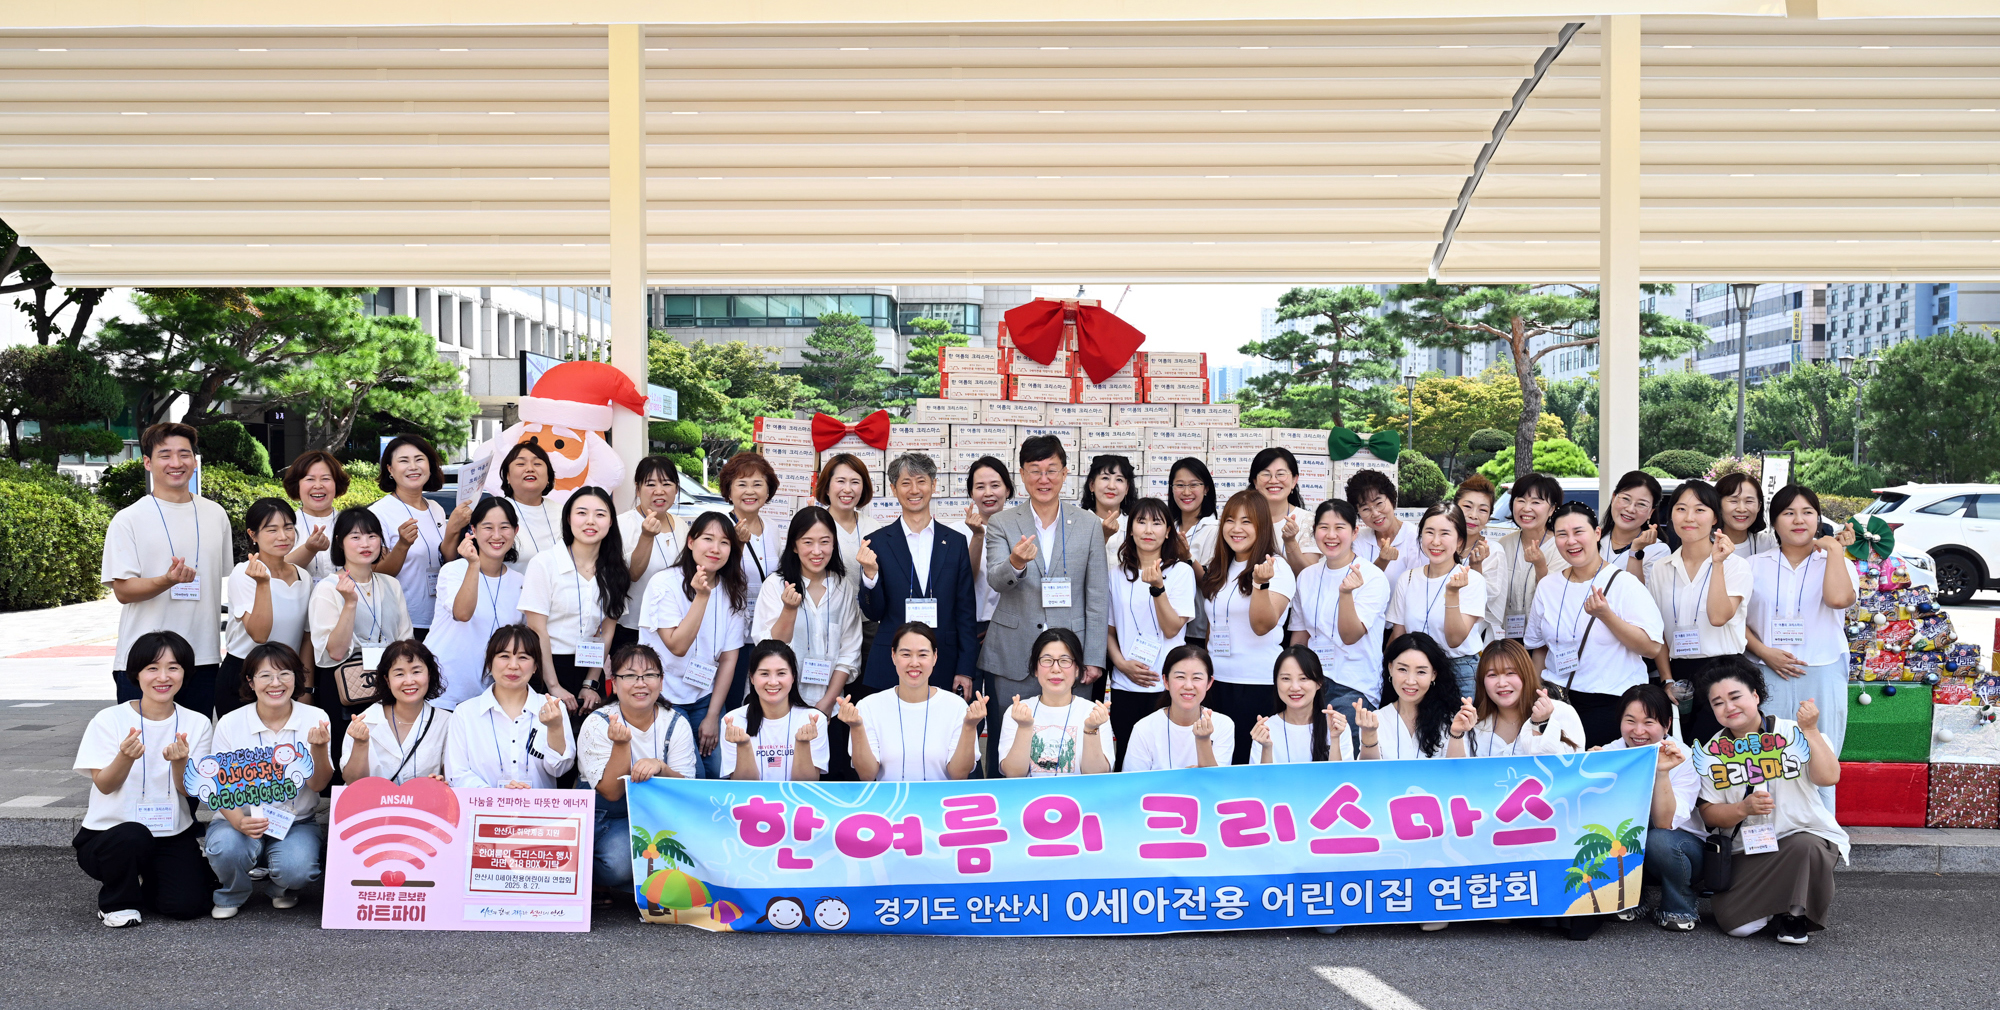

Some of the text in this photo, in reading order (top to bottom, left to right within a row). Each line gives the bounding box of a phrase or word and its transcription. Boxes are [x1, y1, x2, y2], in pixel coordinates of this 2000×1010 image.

[1718, 734, 1777, 758] 한여름의
[1710, 752, 1801, 789] 크리스마스
[381, 795, 414, 806] ANSAN
[469, 797, 589, 809] 나눔을 전파하는 따뜻한 에너지
[494, 827, 515, 836] 안산시
[547, 829, 561, 838] 지원
[732, 778, 1558, 875] 한여름의 크리스마스
[514, 850, 554, 860] 크리스마스
[556, 851, 573, 861] 행사
[491, 858, 507, 868] 라면
[526, 859, 540, 869] BOX
[543, 860, 560, 870] 기탁
[474, 873, 494, 881] 안산시
[552, 876, 572, 884] 연합회
[504, 882, 521, 890] 2025.
[358, 891, 427, 902] 작은사랑 큰보람
[874, 869, 1540, 926] 경기도 안산시 0세아전용 어린이집 연합회
[356, 904, 427, 922] 하트파이
